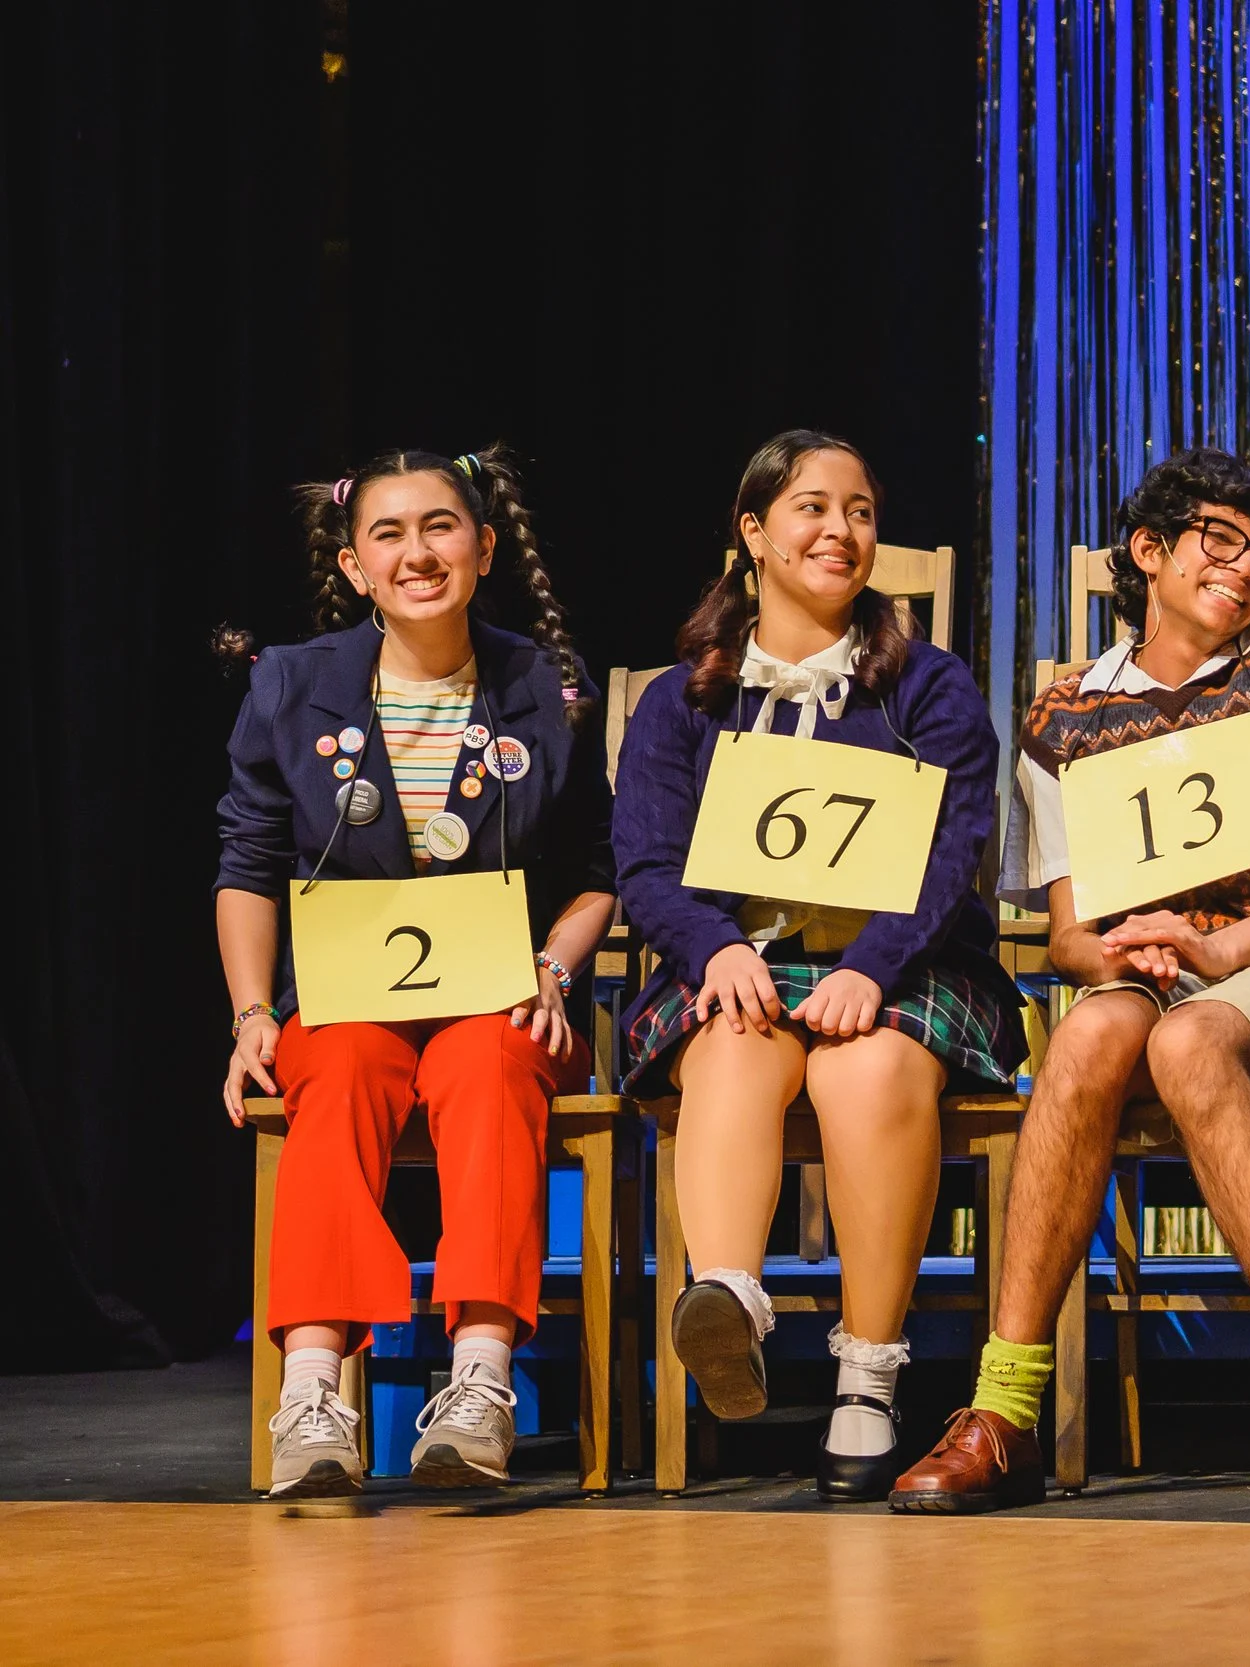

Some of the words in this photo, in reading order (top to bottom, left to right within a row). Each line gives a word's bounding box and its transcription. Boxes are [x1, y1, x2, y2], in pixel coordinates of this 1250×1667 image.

[465, 733, 485, 746] PBS
[755, 787, 877, 868] 67
[1128, 772, 1223, 864] 13
[383, 925, 441, 992] 2
